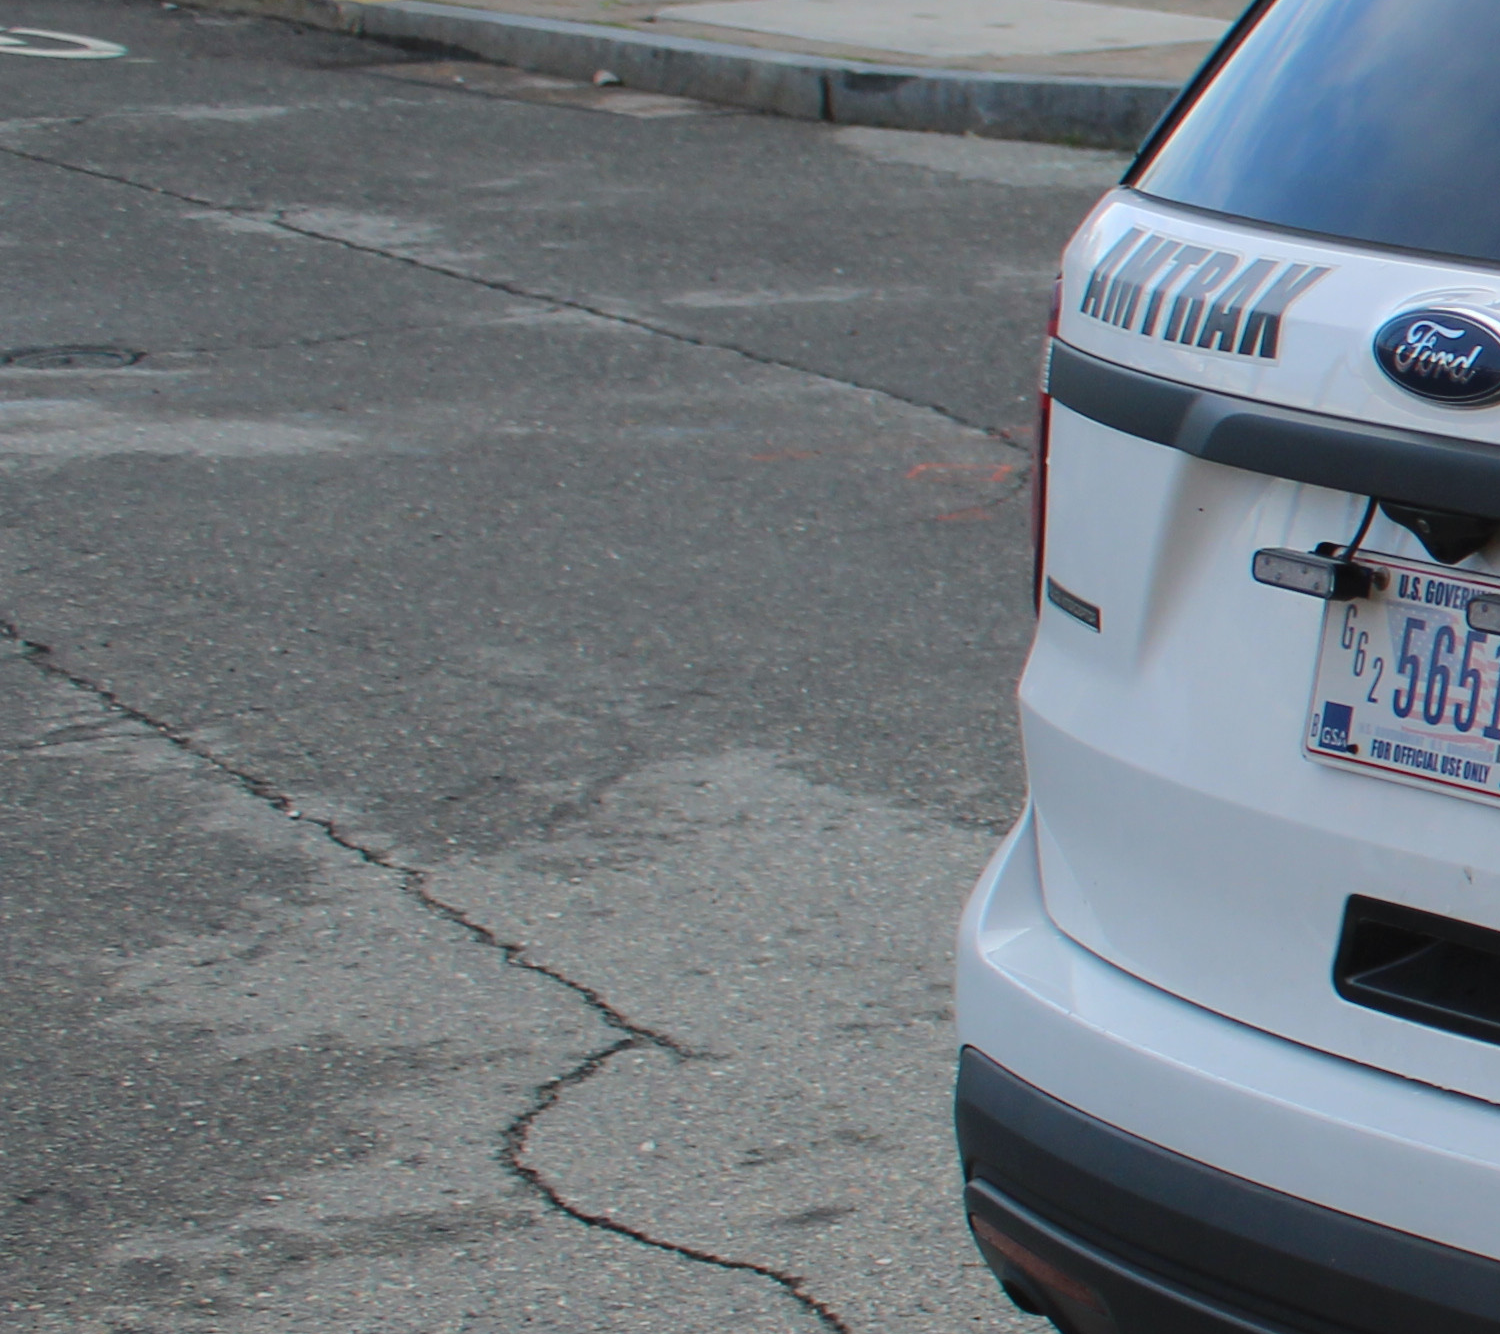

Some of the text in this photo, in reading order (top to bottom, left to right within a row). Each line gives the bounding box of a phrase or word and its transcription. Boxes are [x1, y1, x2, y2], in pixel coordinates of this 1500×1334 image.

[1079, 228, 1333, 360] AMTRAK
[1395, 320, 1482, 383] Ford
[1399, 574, 1421, 601] U.S.
[1322, 725, 1348, 746] GSA
[1371, 739, 1391, 760] FOR
[1394, 744, 1438, 772] OFFICIAL
[1441, 755, 1461, 776] USE
[1464, 761, 1490, 784] ONLY
